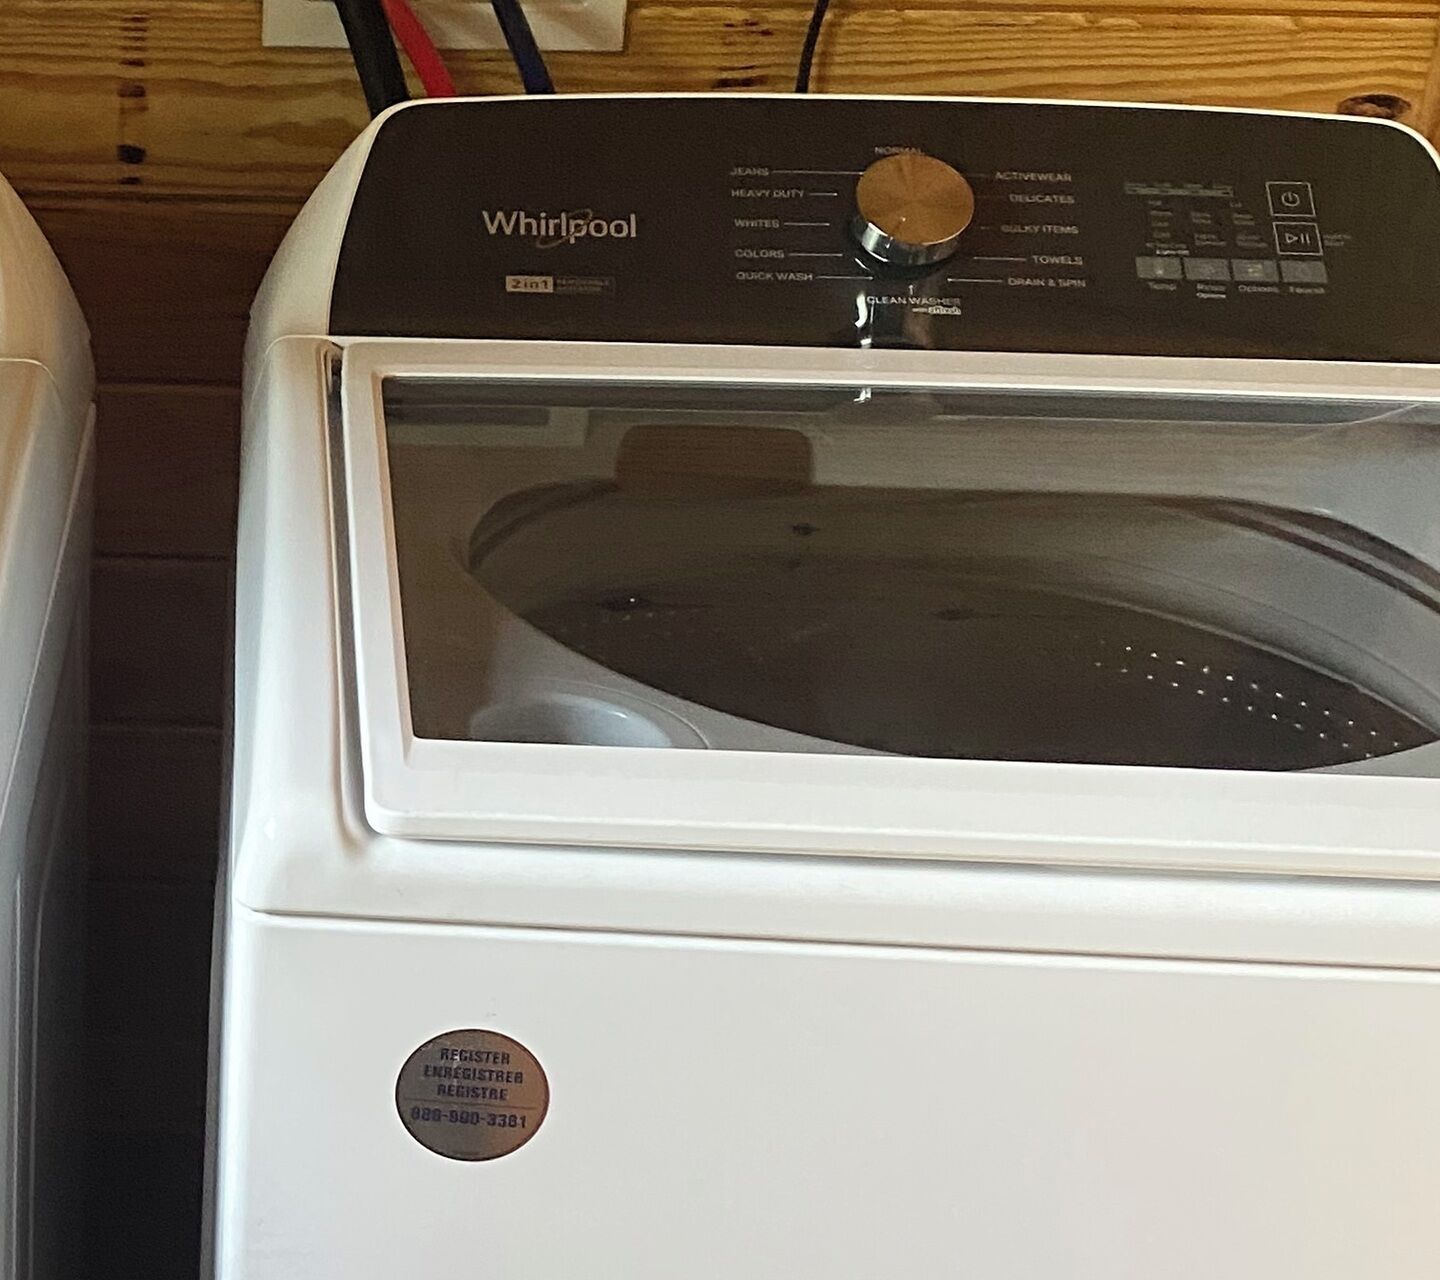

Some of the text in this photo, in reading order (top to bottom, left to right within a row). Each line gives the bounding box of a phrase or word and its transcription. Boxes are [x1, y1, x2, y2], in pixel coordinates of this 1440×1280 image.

[730, 167, 769, 177] JEANS
[995, 171, 1072, 182] ACTIVEWEAR
[731, 189, 805, 198] HEAVY DUTY
[1009, 194, 1076, 204] DELICATES
[482, 209, 638, 246] Whirlpool
[734, 219, 780, 228] WHITES
[1043, 225, 1080, 235] ITEMS
[735, 249, 785, 259] COLORS
[1032, 255, 1084, 265] TOWELS
[736, 272, 814, 281] QUICK WASH
[1007, 277, 1046, 287] DRAIN
[1059, 279, 1086, 288] SPIN
[867, 296, 962, 306] CLEAN WASHER
[440, 1048, 511, 1065] REGISTER
[424, 1064, 524, 1084] ENREGISTRER
[437, 1083, 509, 1102] REGISTRE
